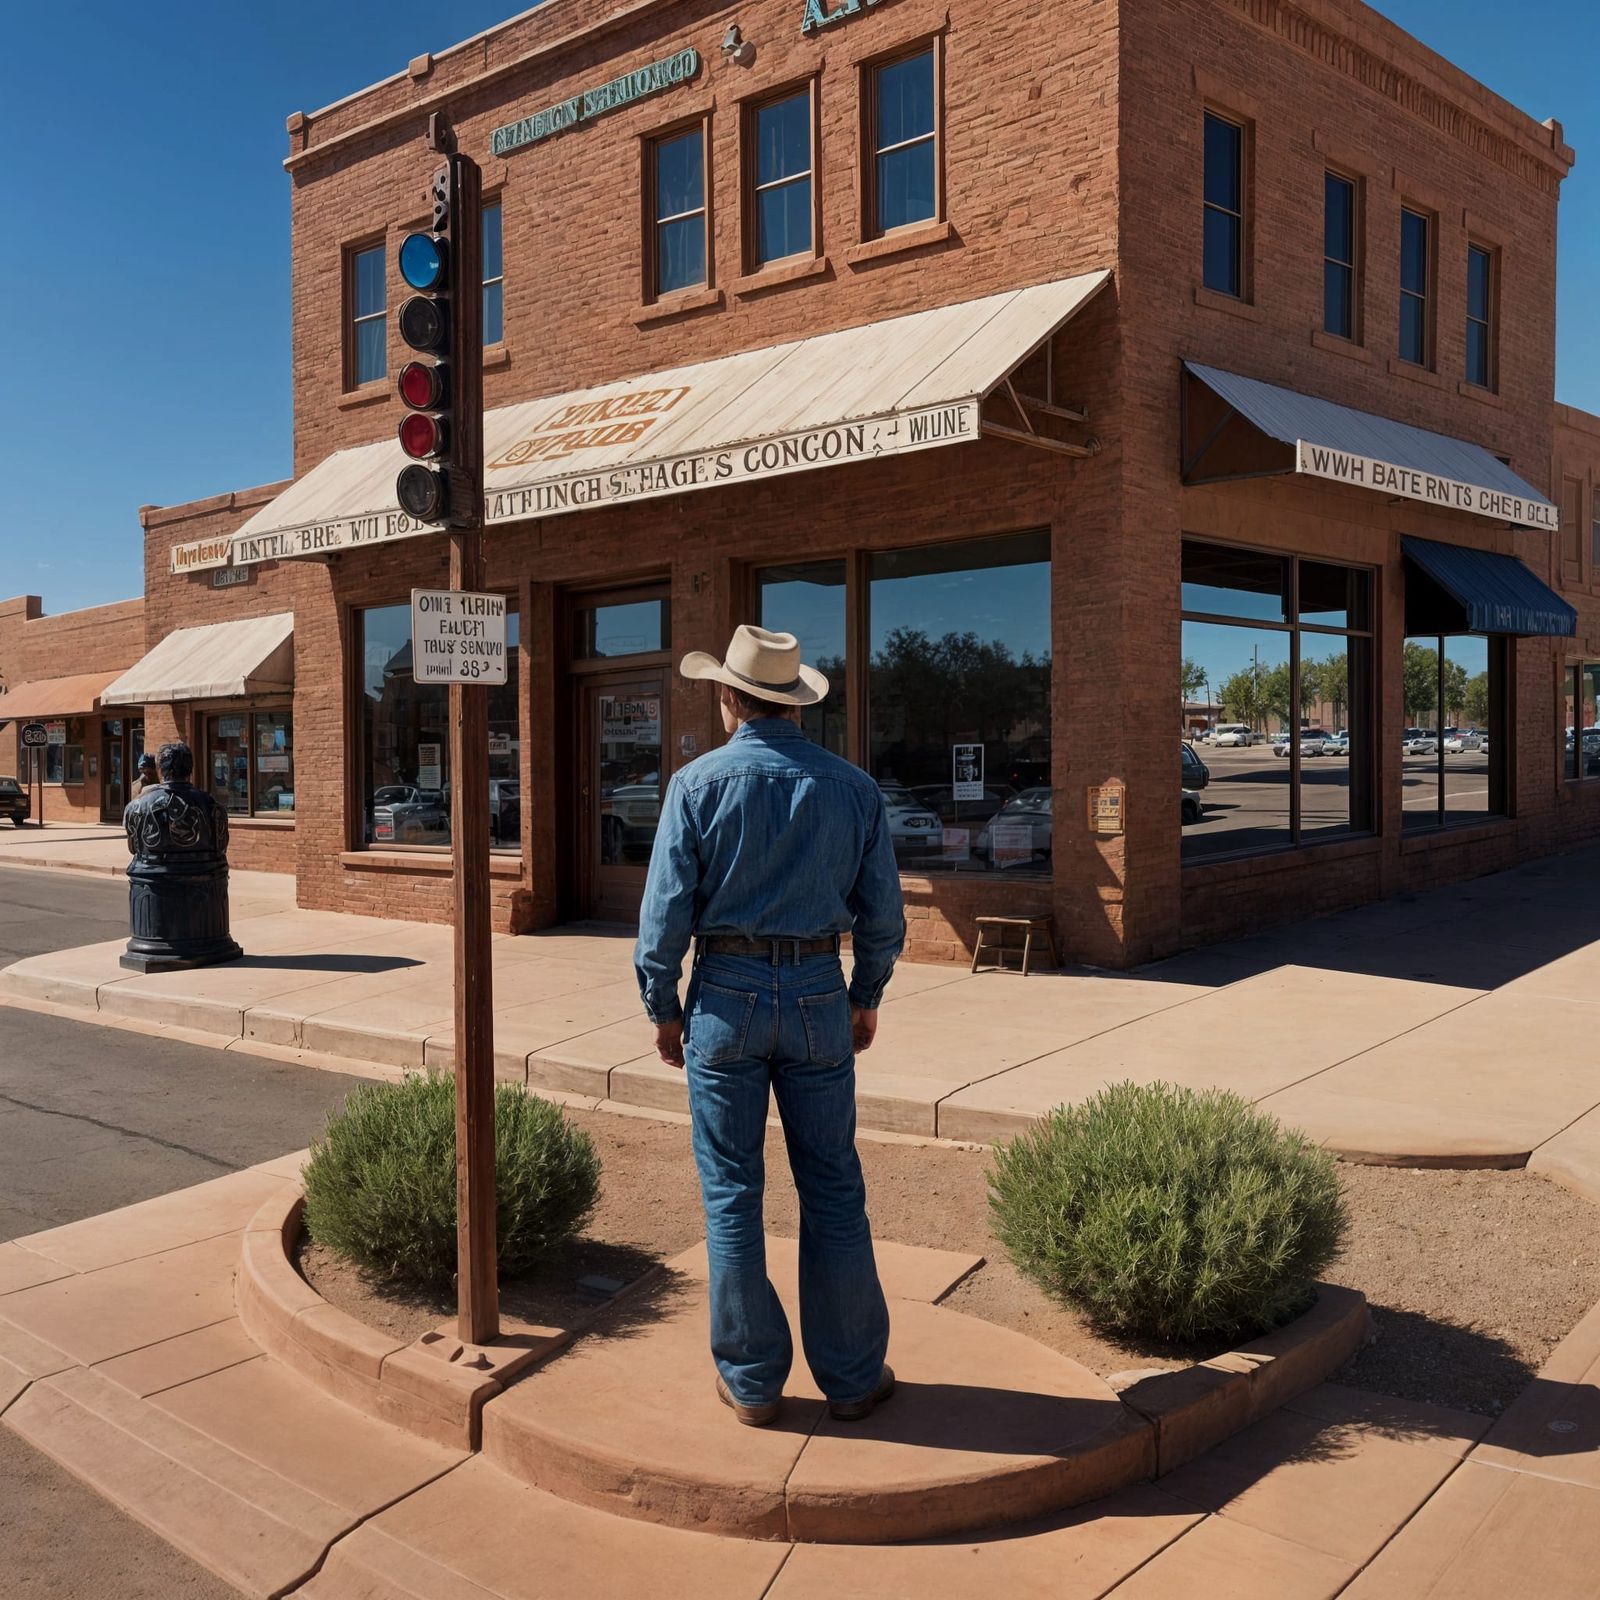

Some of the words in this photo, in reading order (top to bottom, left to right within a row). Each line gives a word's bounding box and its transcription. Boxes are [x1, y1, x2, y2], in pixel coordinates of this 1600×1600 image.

[743, 424, 865, 473] CONGON
[1311, 447, 1364, 482] WWH
[1479, 490, 1522, 520] CHER
